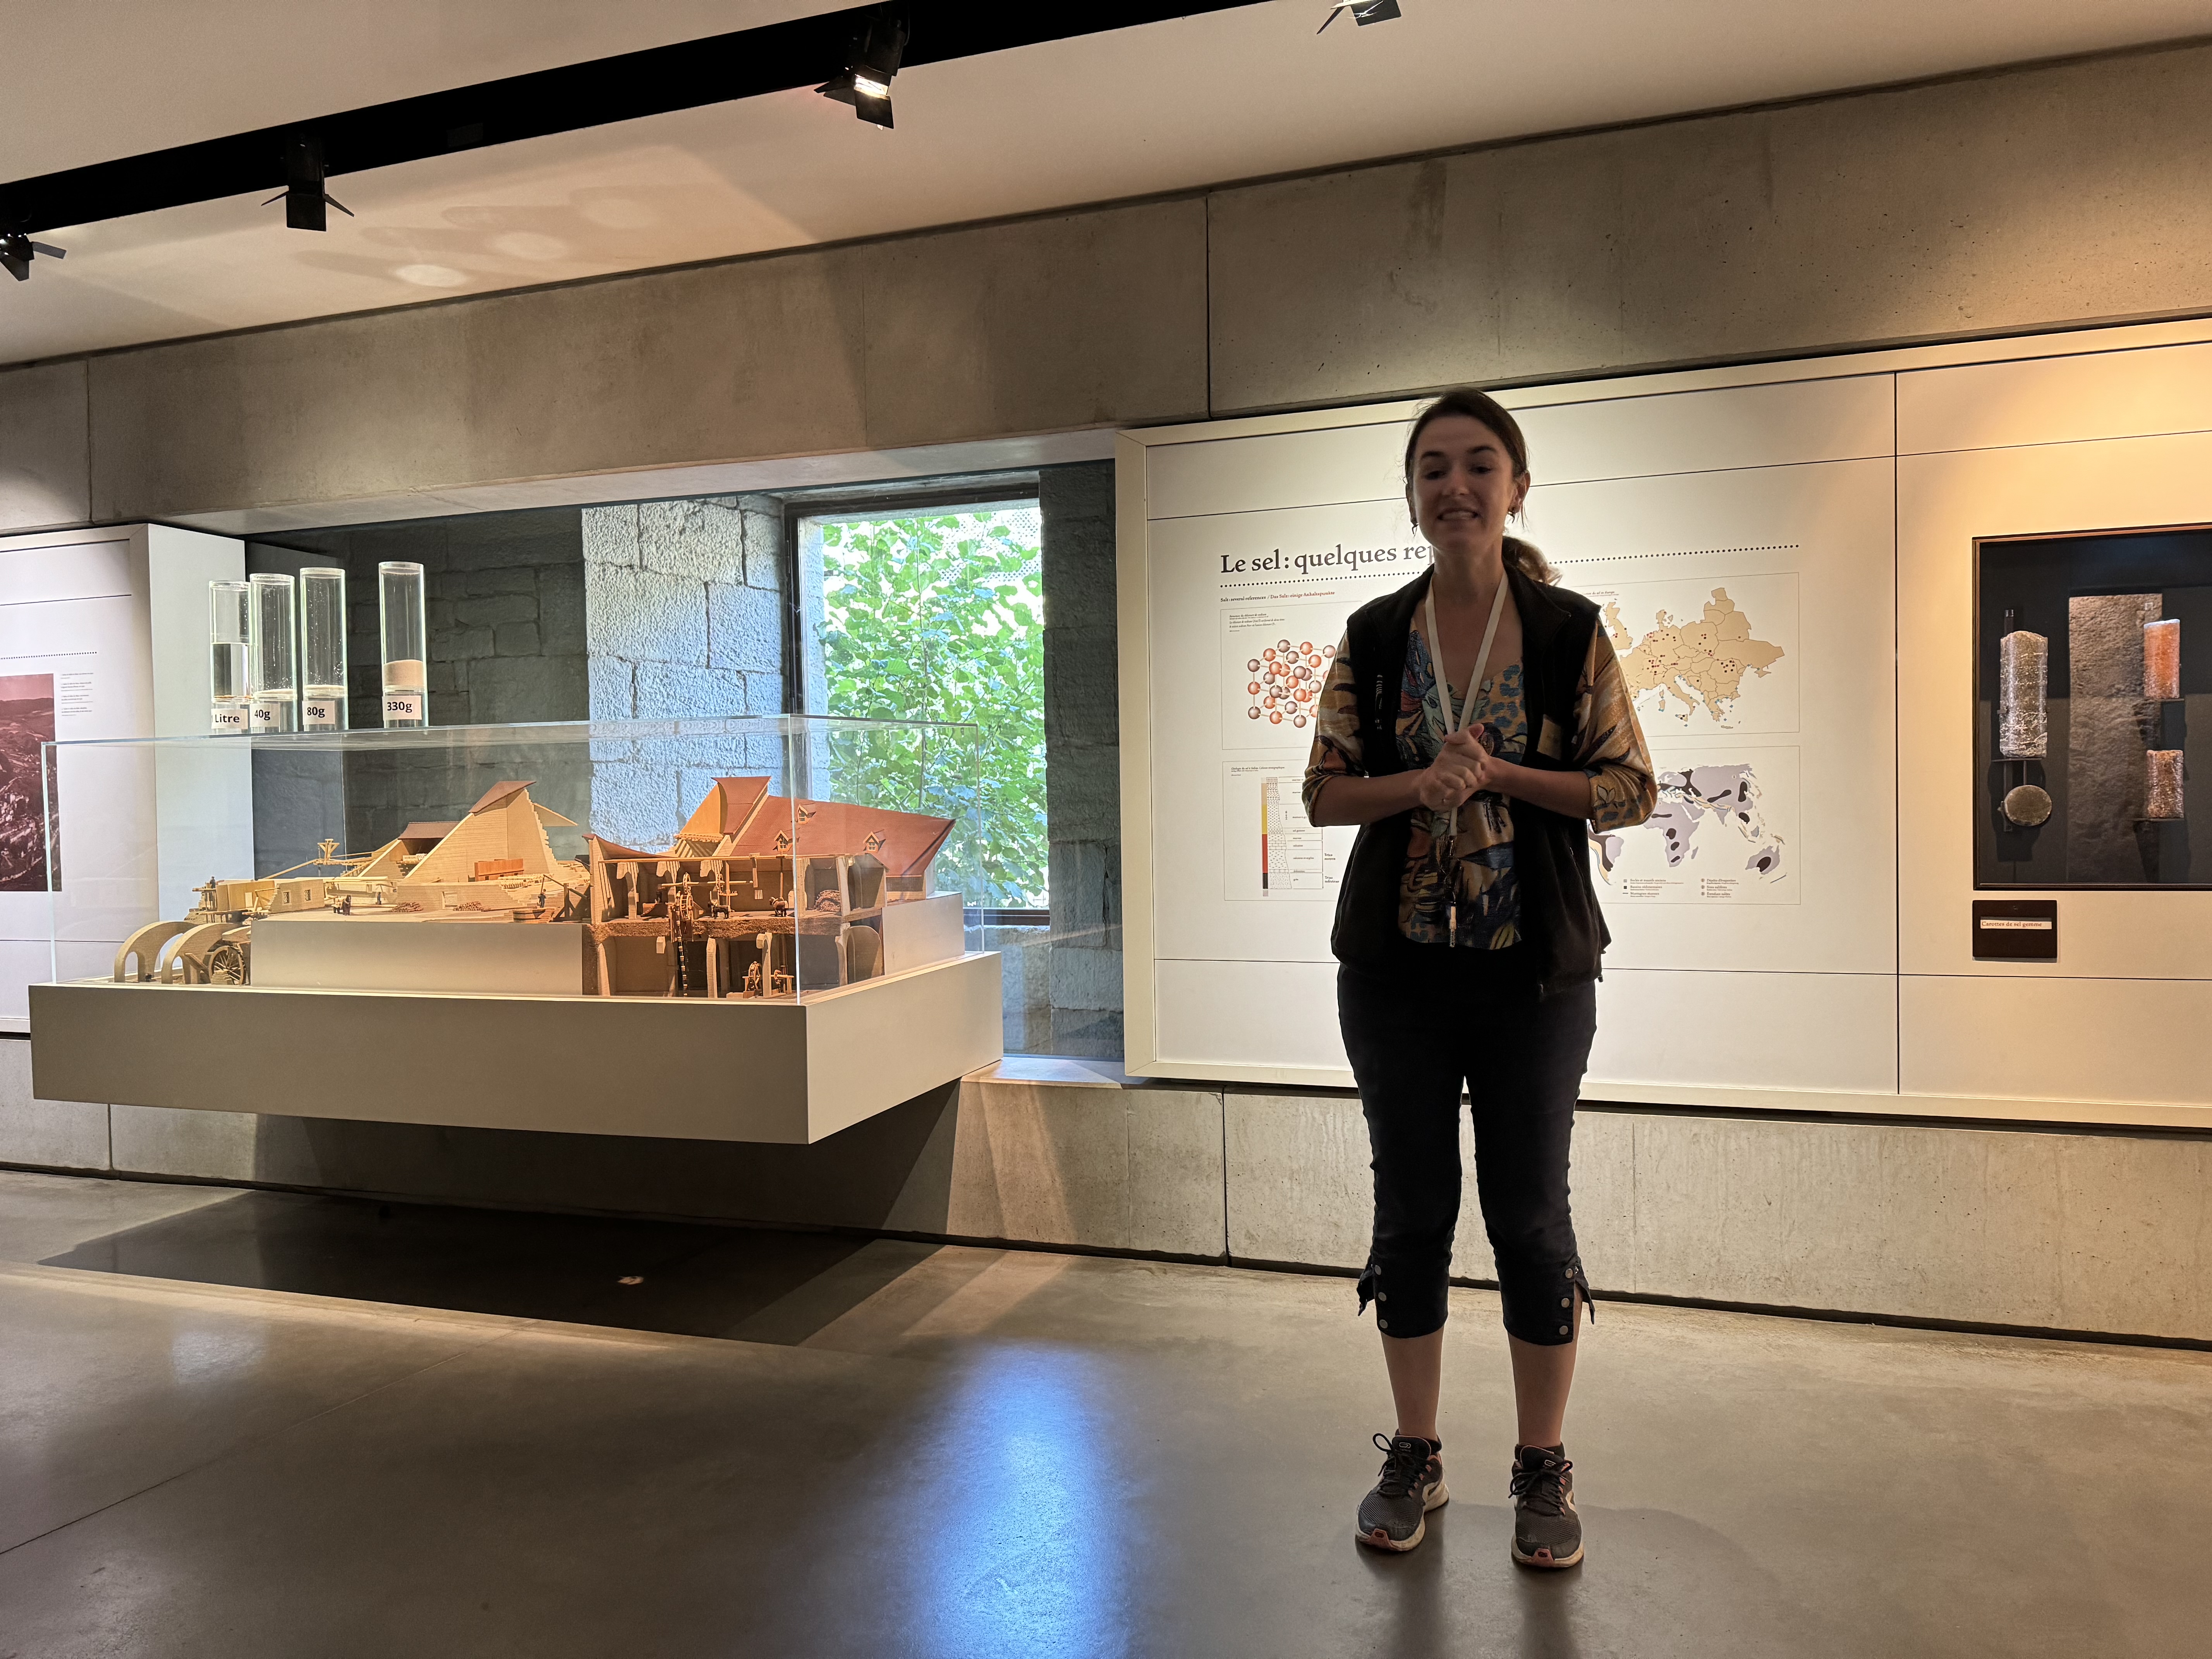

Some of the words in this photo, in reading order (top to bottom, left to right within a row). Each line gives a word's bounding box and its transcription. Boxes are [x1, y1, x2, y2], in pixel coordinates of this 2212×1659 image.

[1221, 555, 1247, 573] Le
[1294, 544, 1397, 575] quelques
[307, 707, 325, 718] 80g
[387, 701, 412, 713] 330g
[215, 714, 240, 723] Litre
[254, 709, 271, 720] 40g
